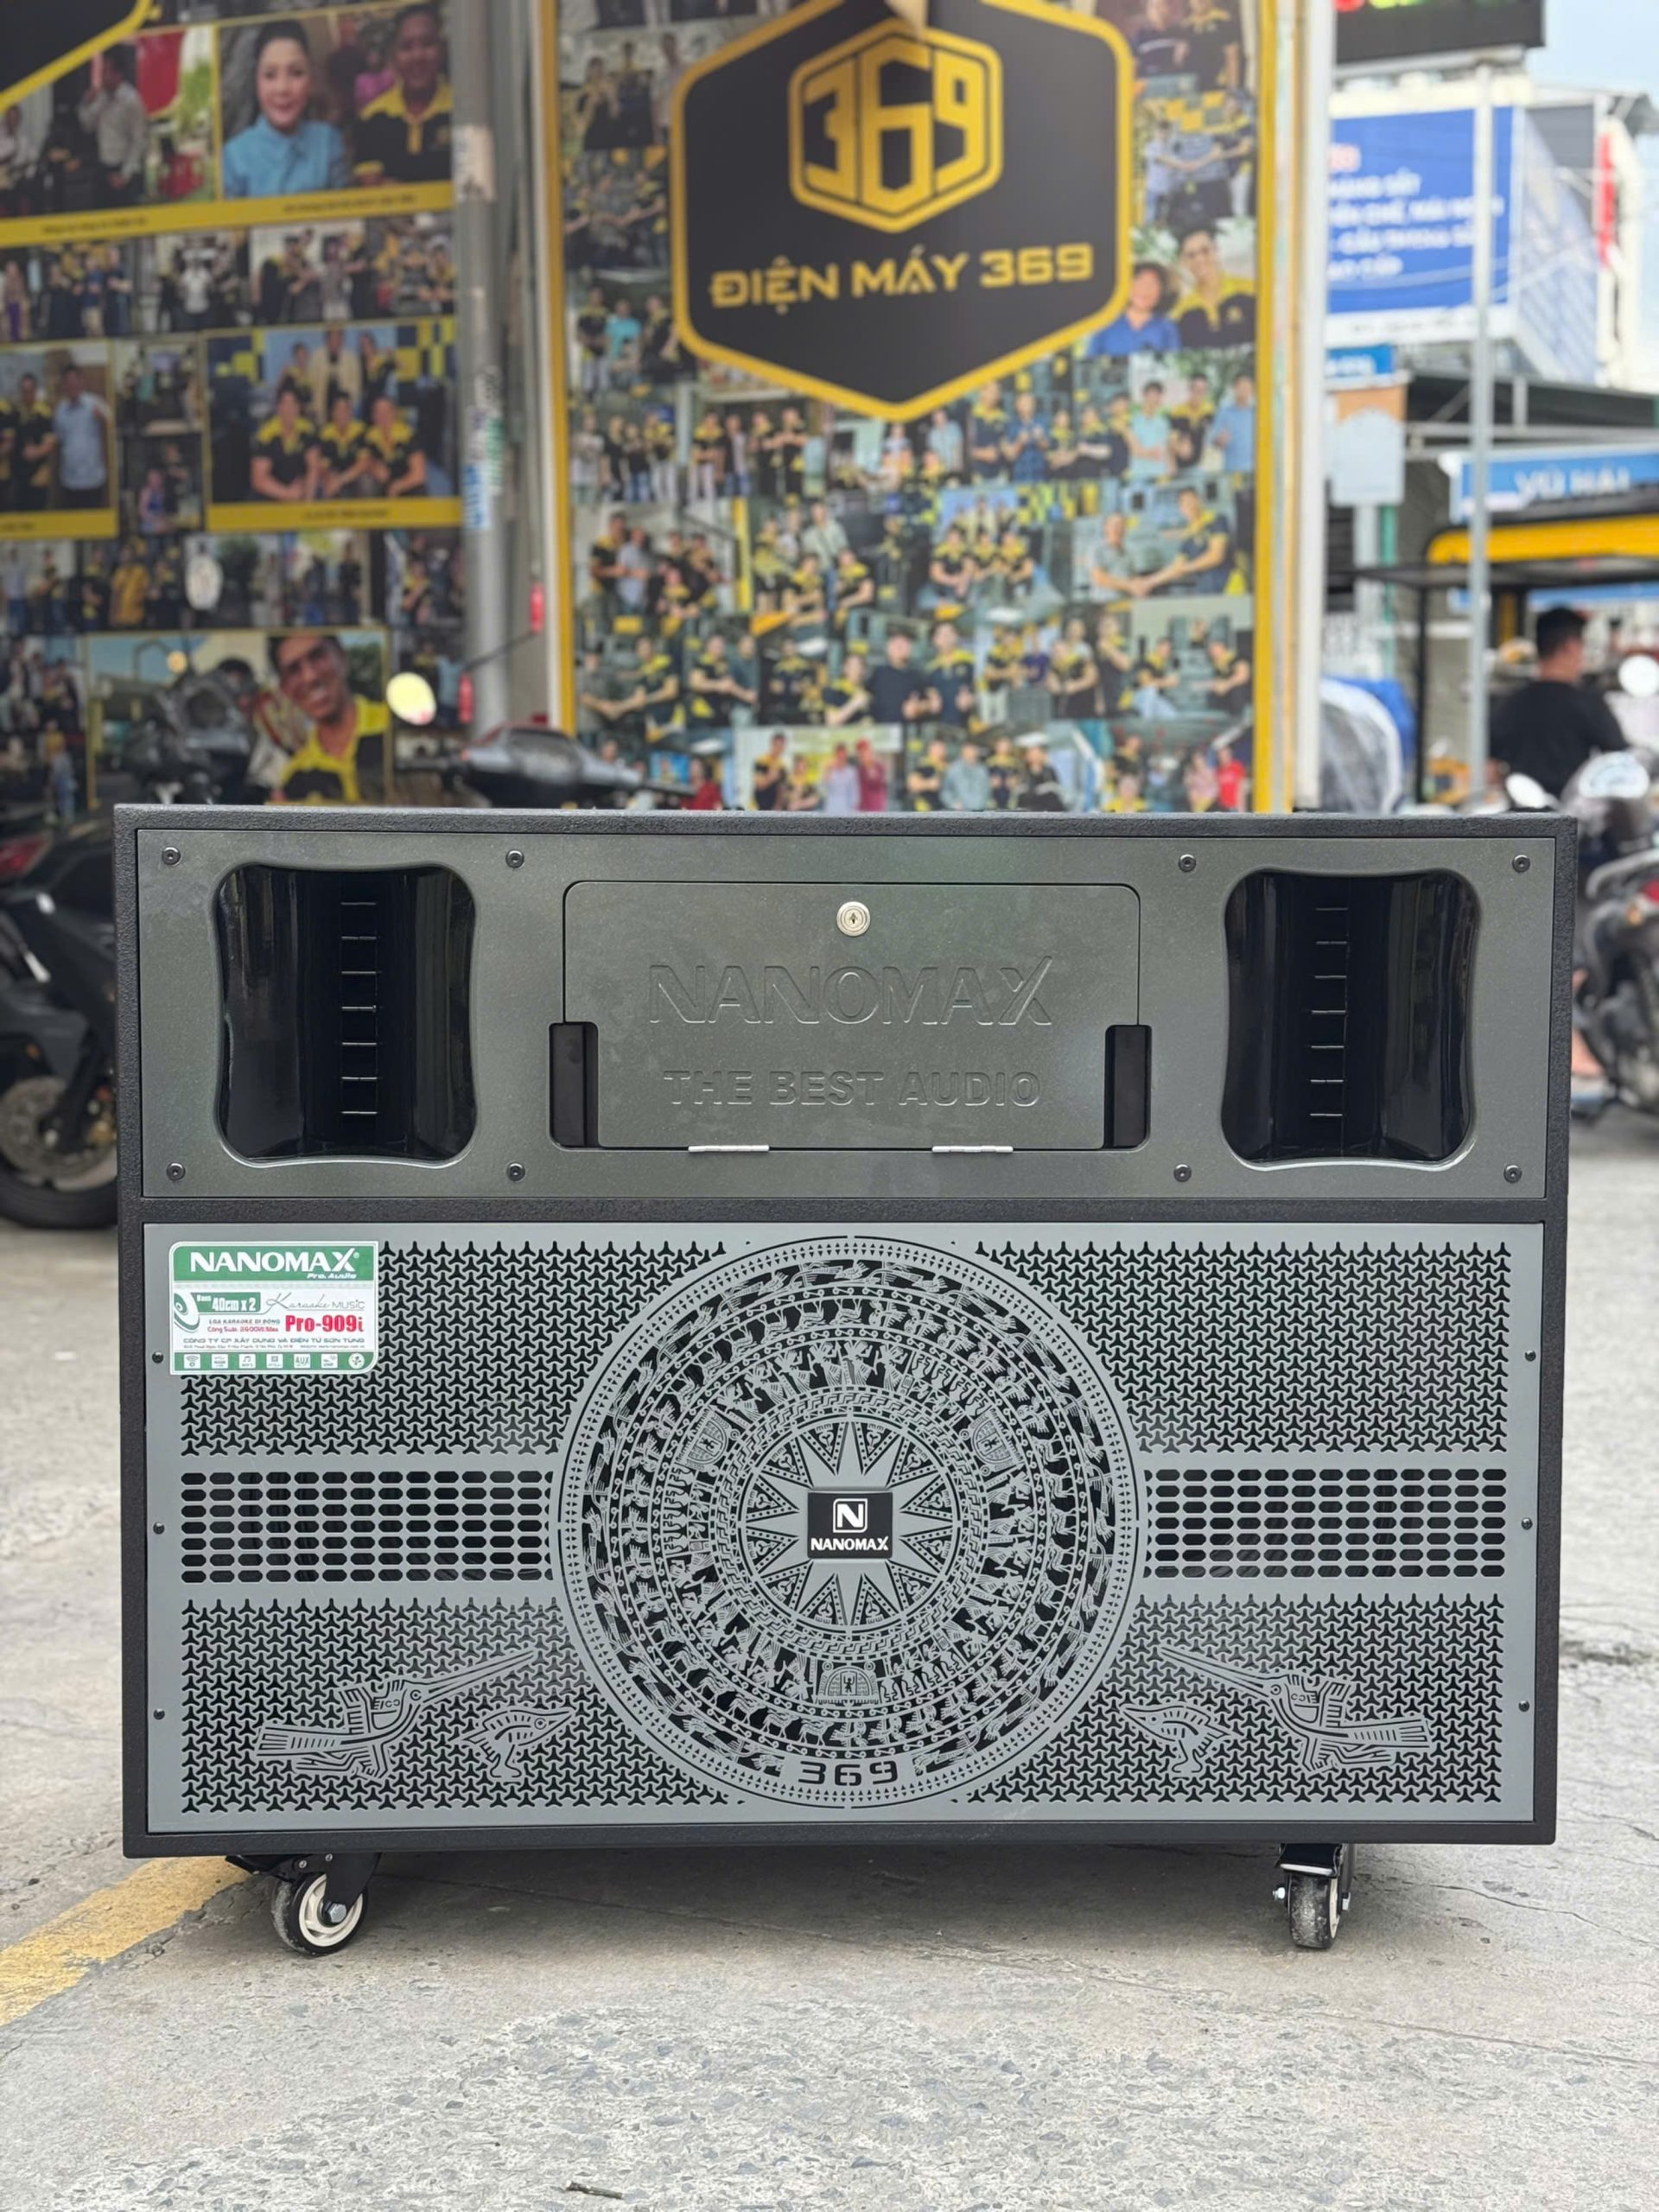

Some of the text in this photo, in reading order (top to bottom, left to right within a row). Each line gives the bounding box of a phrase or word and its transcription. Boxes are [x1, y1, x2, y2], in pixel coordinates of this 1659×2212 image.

[802, 35, 988, 214] 369
[708, 241, 1094, 315] ĐIỆN MÁY 369
[647, 954, 1053, 1026] NANOMAX
[664, 1069, 1041, 1107] THE BEST AUDIO
[190, 1248, 356, 1273] NANOMAX
[212, 1297, 239, 1312] 40cm
[241, 1300, 247, 1312] x
[248, 1297, 257, 1312] 2
[266, 1292, 330, 1310] Karaoke
[285, 1314, 364, 1332] Pro-909i
[295, 1356, 310, 1364] AUX
[836, 1502, 865, 1529] N
[810, 1535, 889, 1551] NANOMAX
[798, 1760, 899, 1786] 369
